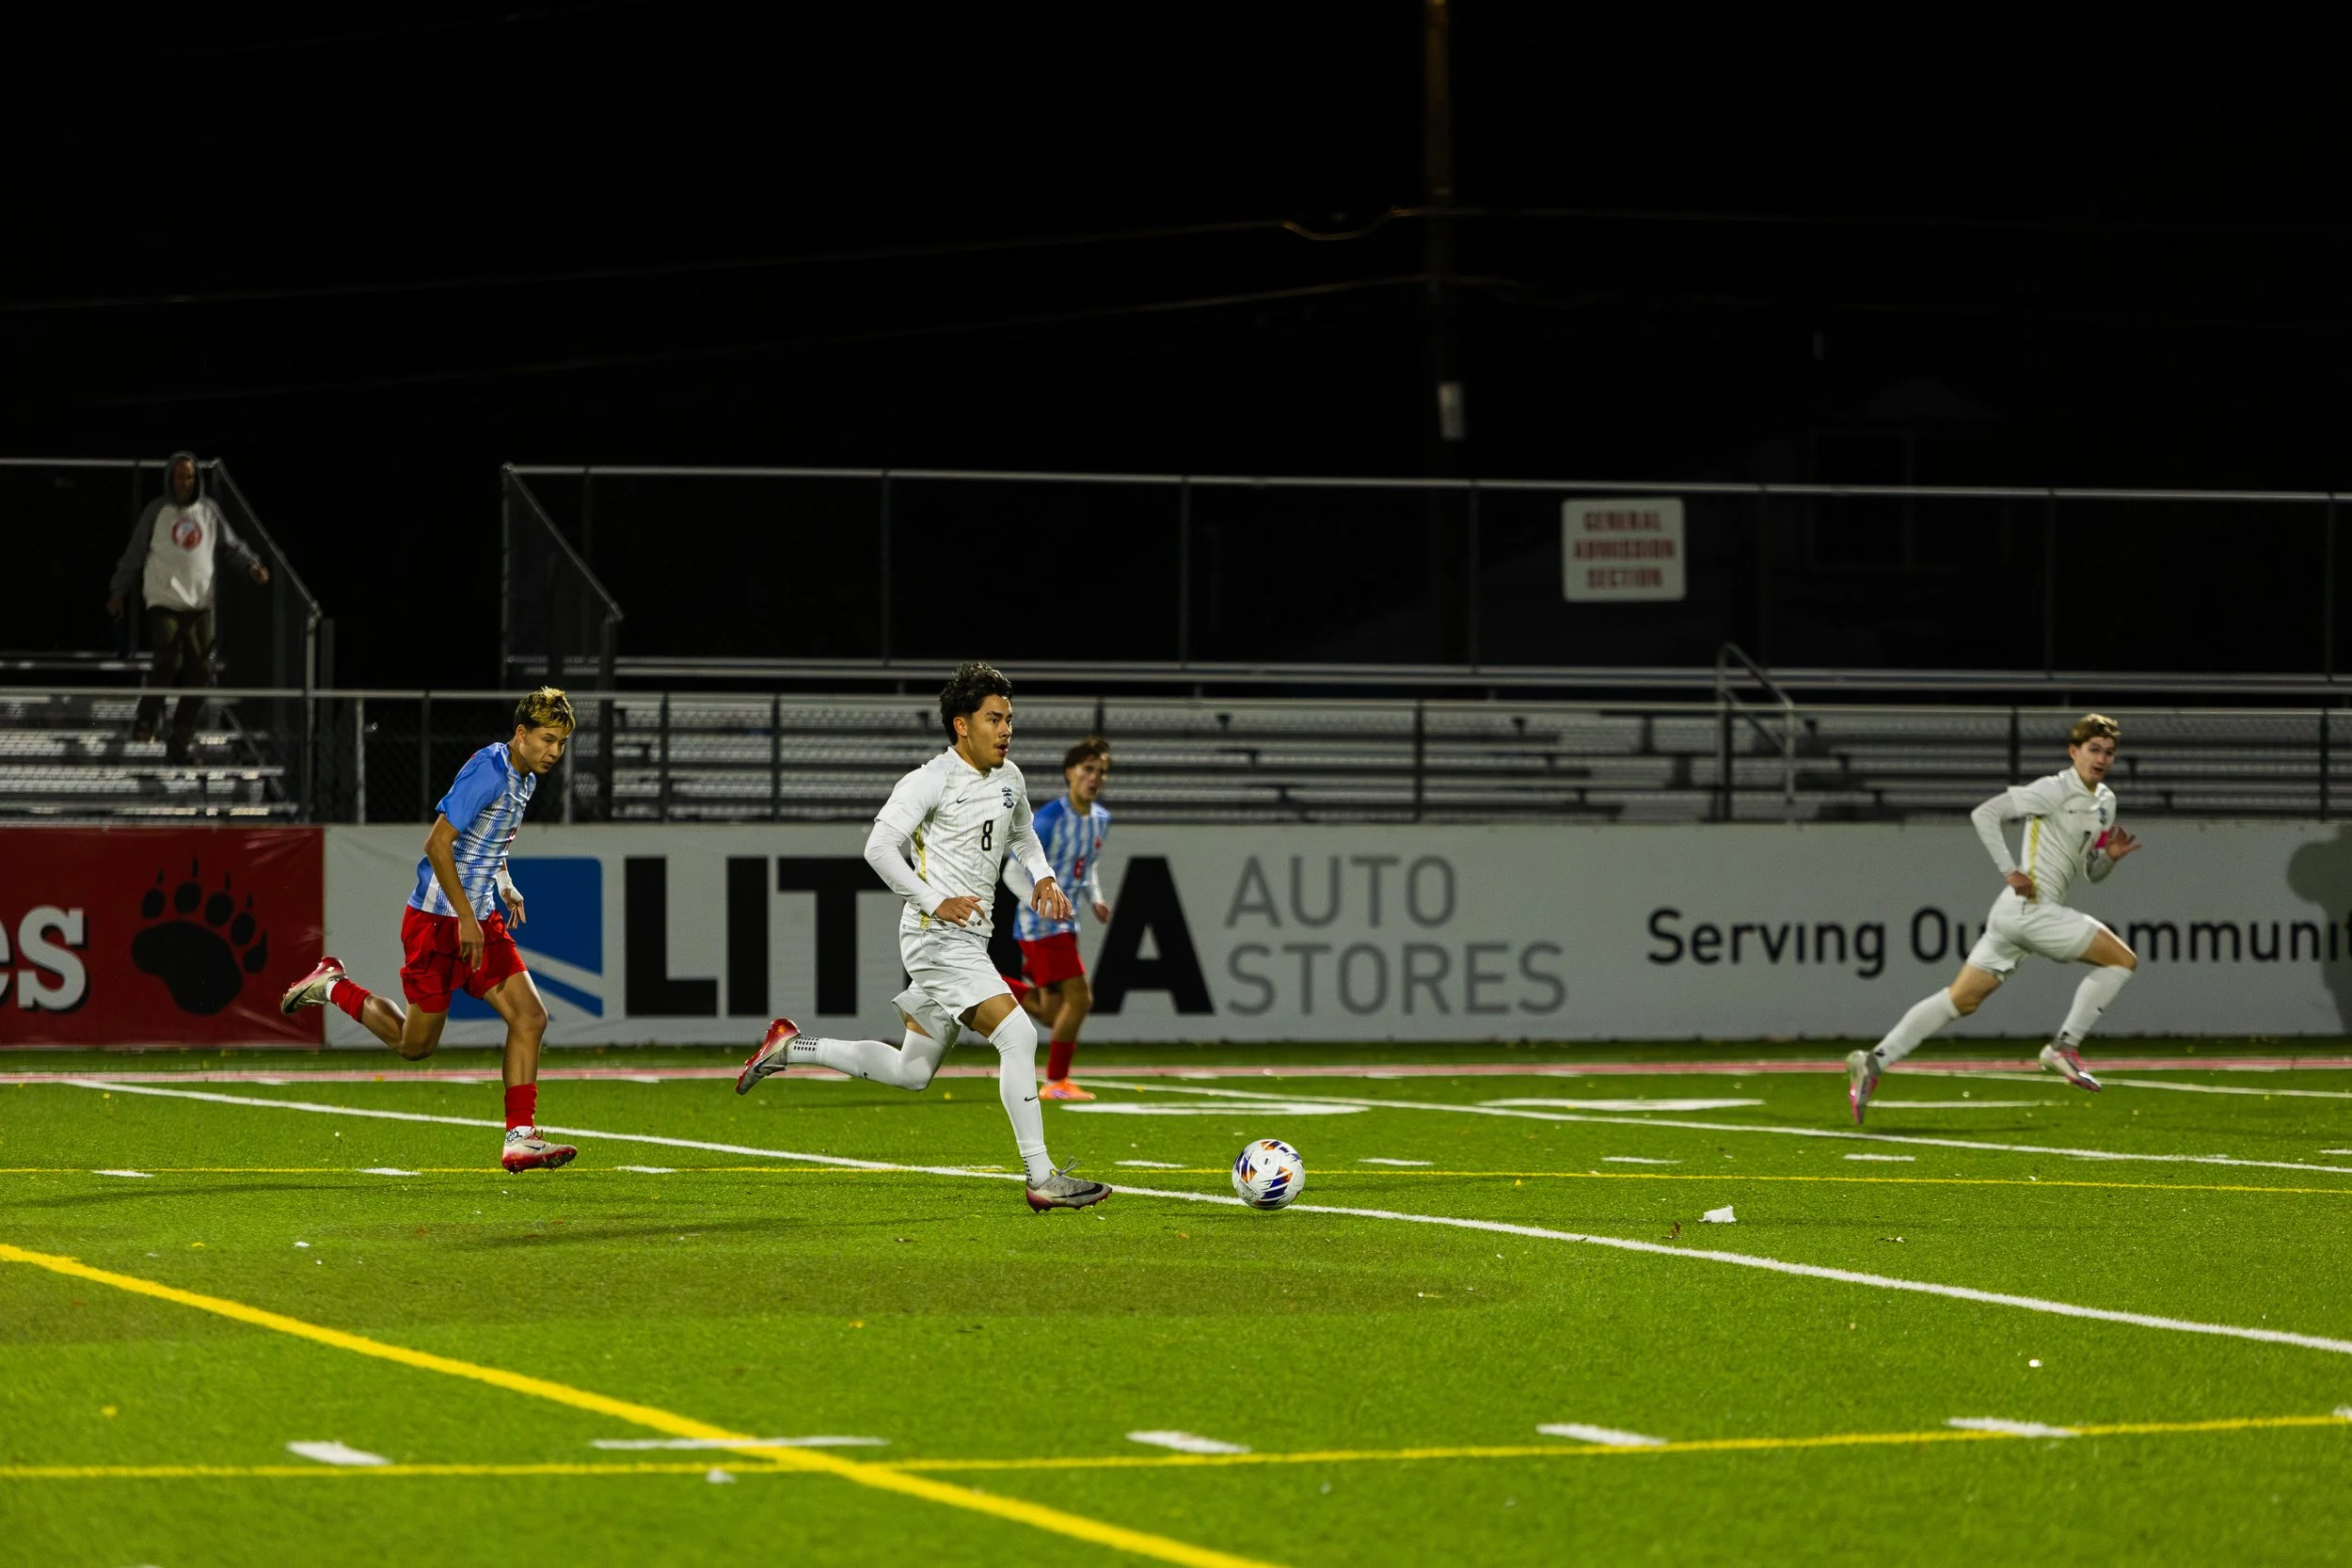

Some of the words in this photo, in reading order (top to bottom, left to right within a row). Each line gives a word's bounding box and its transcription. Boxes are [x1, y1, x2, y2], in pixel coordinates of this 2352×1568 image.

[1575, 538, 1676, 562] ADMISSION
[1583, 510, 1661, 531] GENERAL
[1585, 566, 1662, 589] SECTION
[980, 819, 994, 851] 8
[1225, 855, 1456, 928] AUTO
[0, 905, 87, 1011] s
[624, 857, 1215, 1018] LITA
[1647, 906, 1885, 979] Serving
[1911, 906, 1988, 964] Ou
[1227, 942, 1567, 1016] STORES
